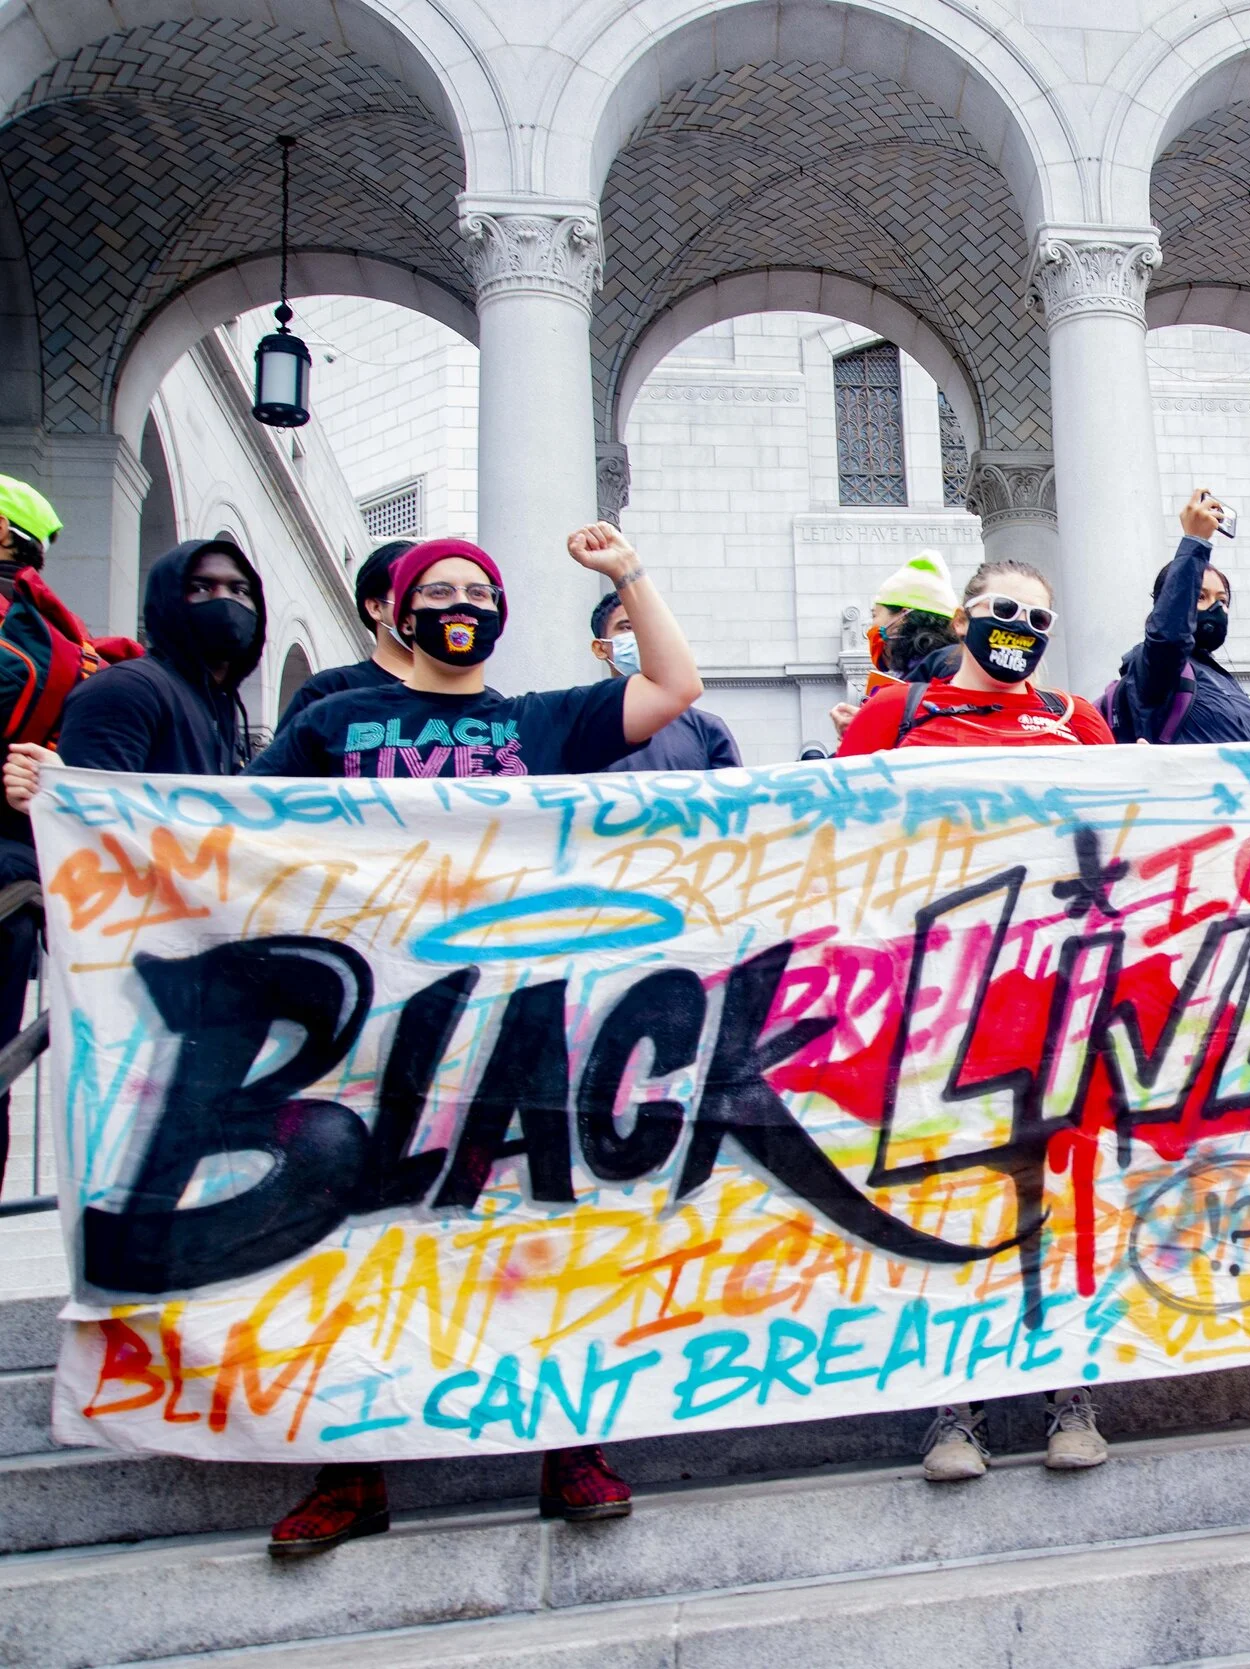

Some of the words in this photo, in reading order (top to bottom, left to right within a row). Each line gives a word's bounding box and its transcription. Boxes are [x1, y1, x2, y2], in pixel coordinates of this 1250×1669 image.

[857, 526, 899, 542] HAVE
[903, 527, 947, 542] FAITH
[988, 628, 1037, 648] DEFUND
[989, 648, 1028, 673] POLICE
[344, 717, 520, 752] BLACK
[55, 780, 407, 829] ENOUGH
[82, 932, 1052, 1295] BLACK
[422, 1338, 664, 1440] CANT
